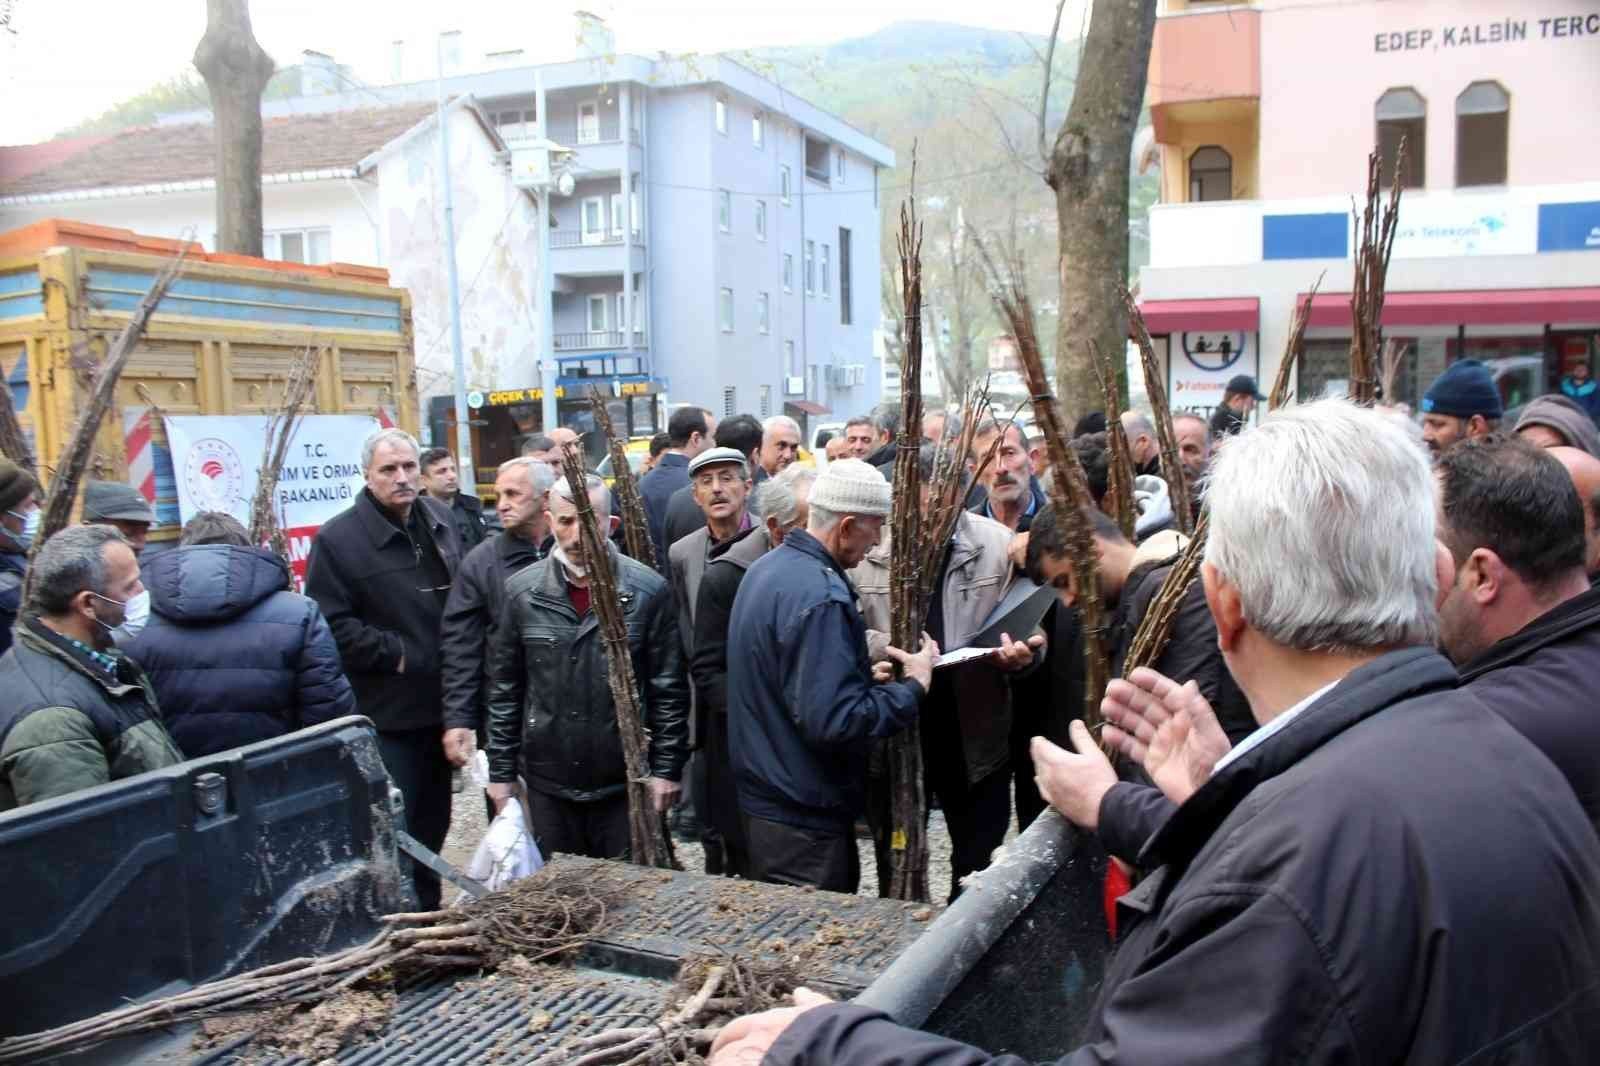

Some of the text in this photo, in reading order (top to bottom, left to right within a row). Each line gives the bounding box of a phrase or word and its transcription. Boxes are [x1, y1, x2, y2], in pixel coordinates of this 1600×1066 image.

[1443, 18, 1527, 48] KALBİN
[1538, 13, 1600, 38] TERC
[303, 443, 328, 458] T.C.
[302, 465, 319, 480] VE
[322, 463, 361, 479] ORMA
[280, 482, 353, 504] BAKANLIĞI
